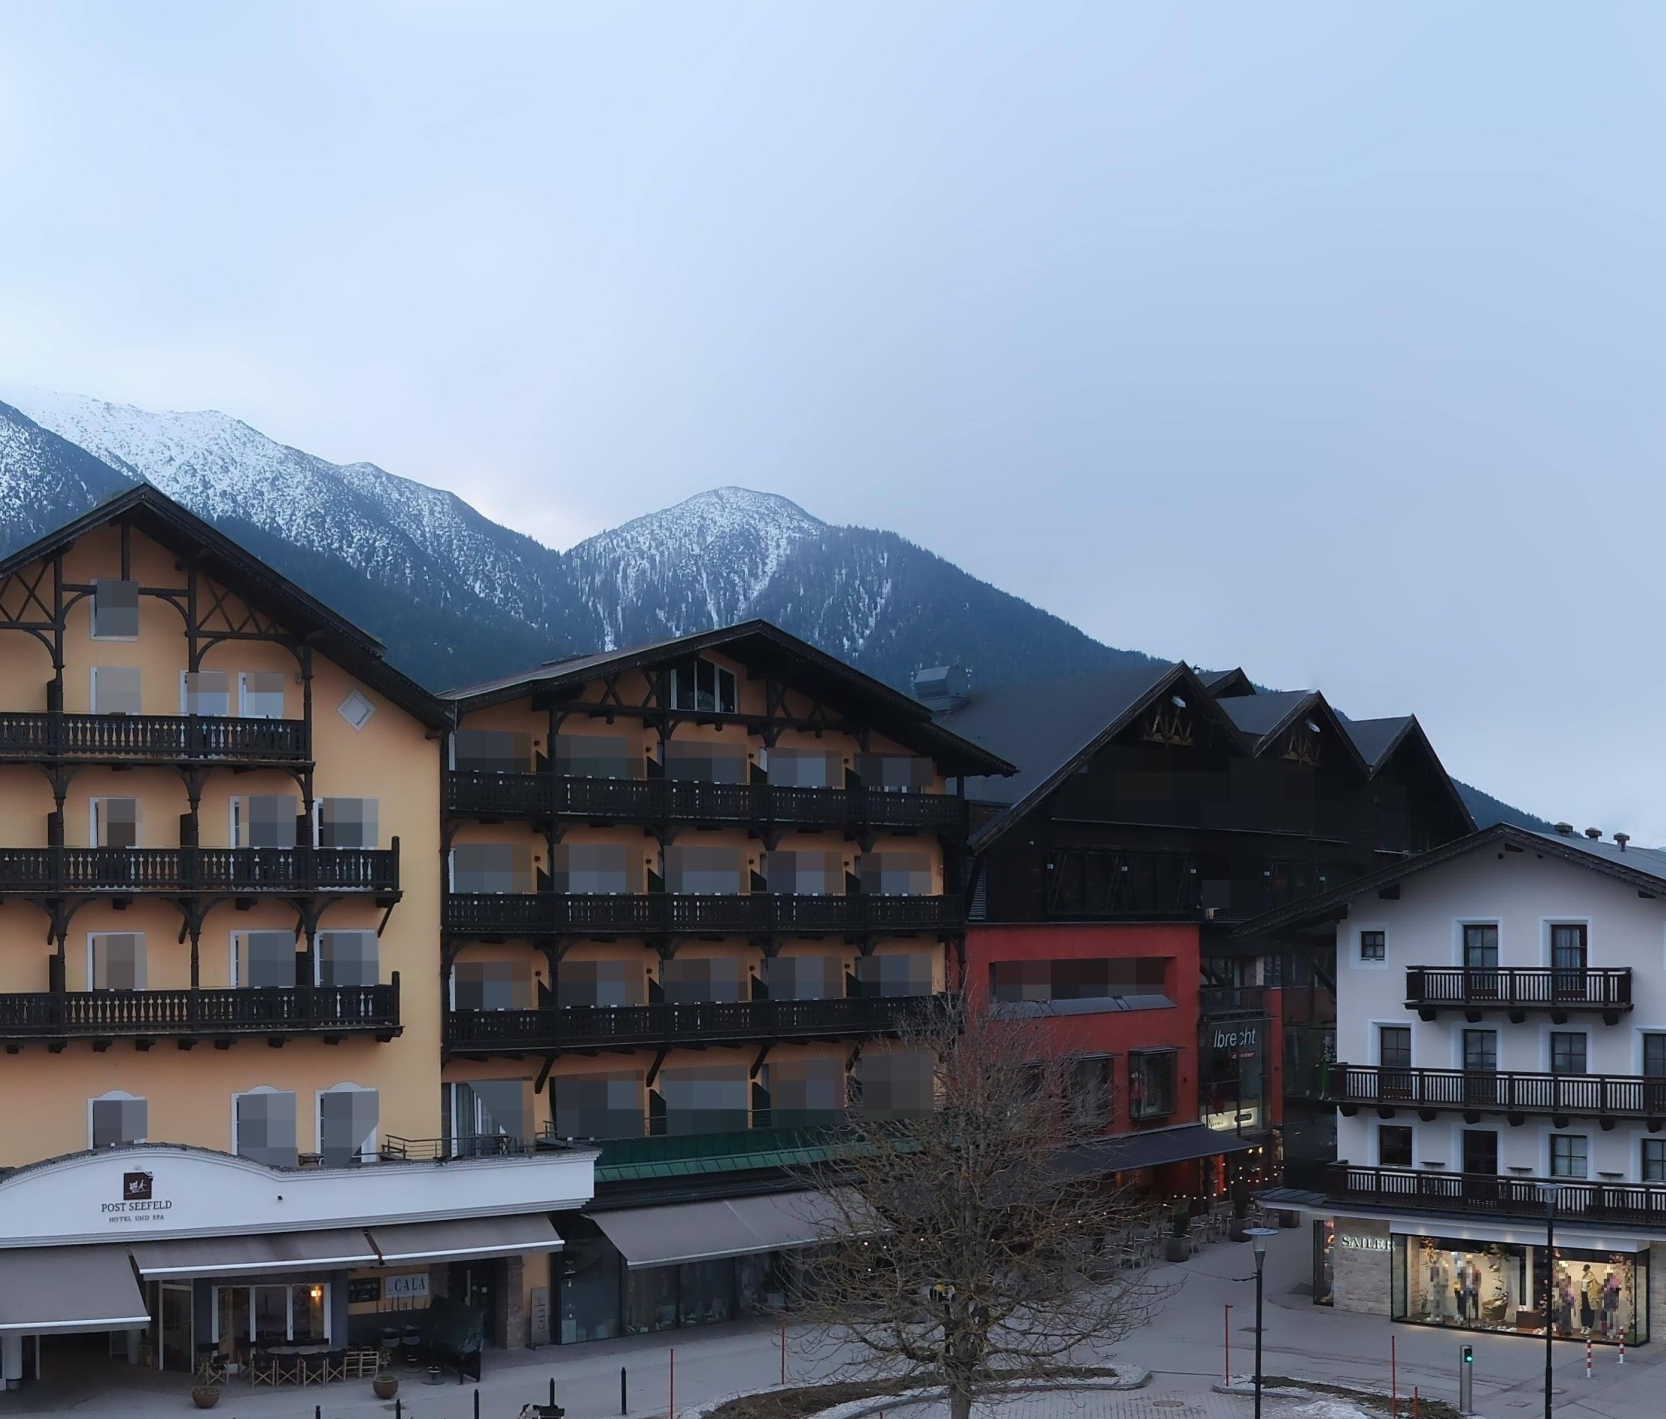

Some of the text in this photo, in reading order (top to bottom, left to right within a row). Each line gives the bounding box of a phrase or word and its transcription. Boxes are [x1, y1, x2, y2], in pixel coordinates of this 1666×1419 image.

[101, 1200, 172, 1213] POST SEEFELD
[1341, 1234, 1396, 1252] SAILER
[394, 1277, 426, 1292] CALA
